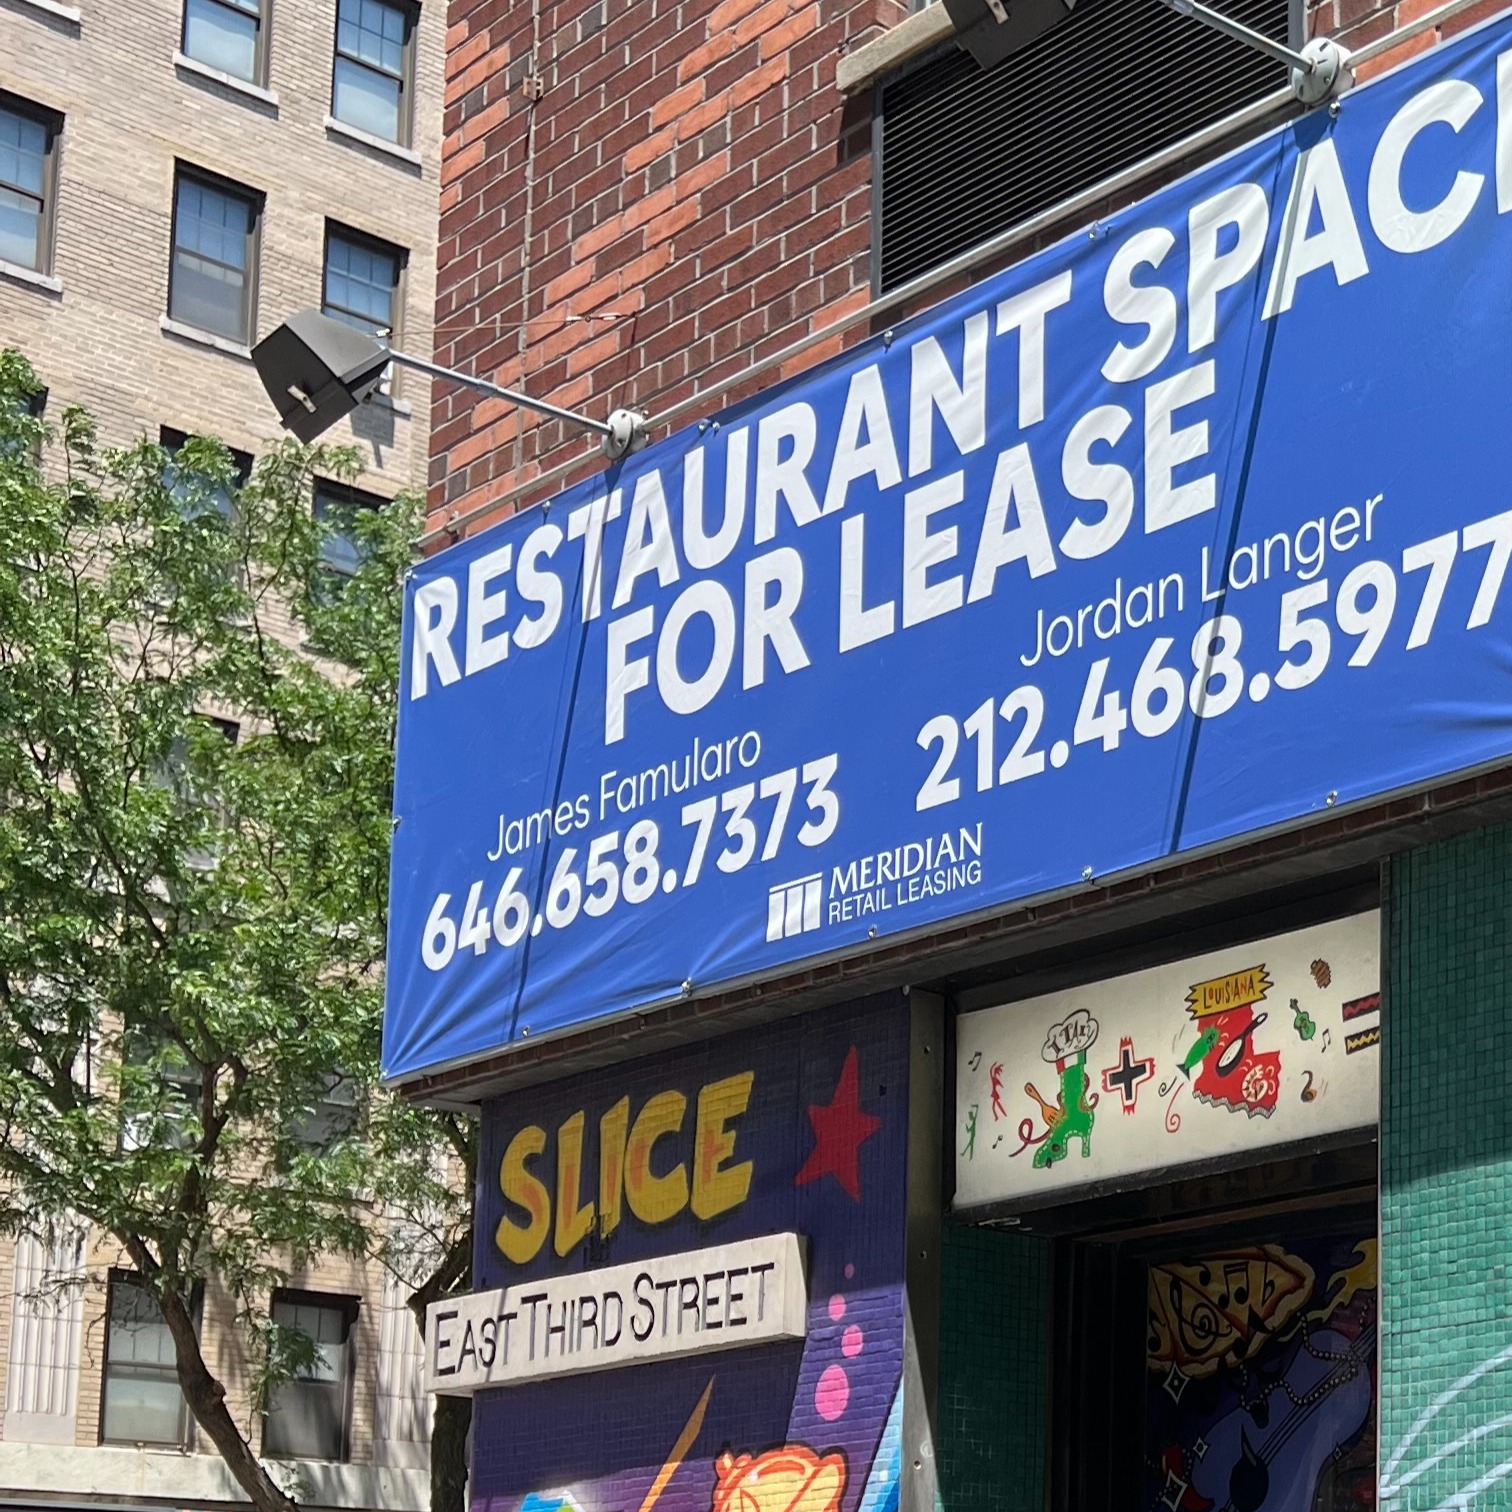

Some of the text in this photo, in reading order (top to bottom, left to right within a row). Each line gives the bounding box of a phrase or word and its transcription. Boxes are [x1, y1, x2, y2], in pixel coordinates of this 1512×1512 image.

[410, 269, 1072, 702] RESTAURANT
[604, 359, 1216, 746] FOR LEASE
[1019, 493, 1384, 667] Jordan Langer
[420, 753, 840, 971] 646.658.7373
[486, 730, 761, 861] James Famularo
[828, 822, 983, 899] MERIDIAN
[828, 860, 982, 925] RETAIL LEASING
[1203, 974, 1256, 1010] LOUISIANA
[495, 1070, 755, 1265] SLICE
